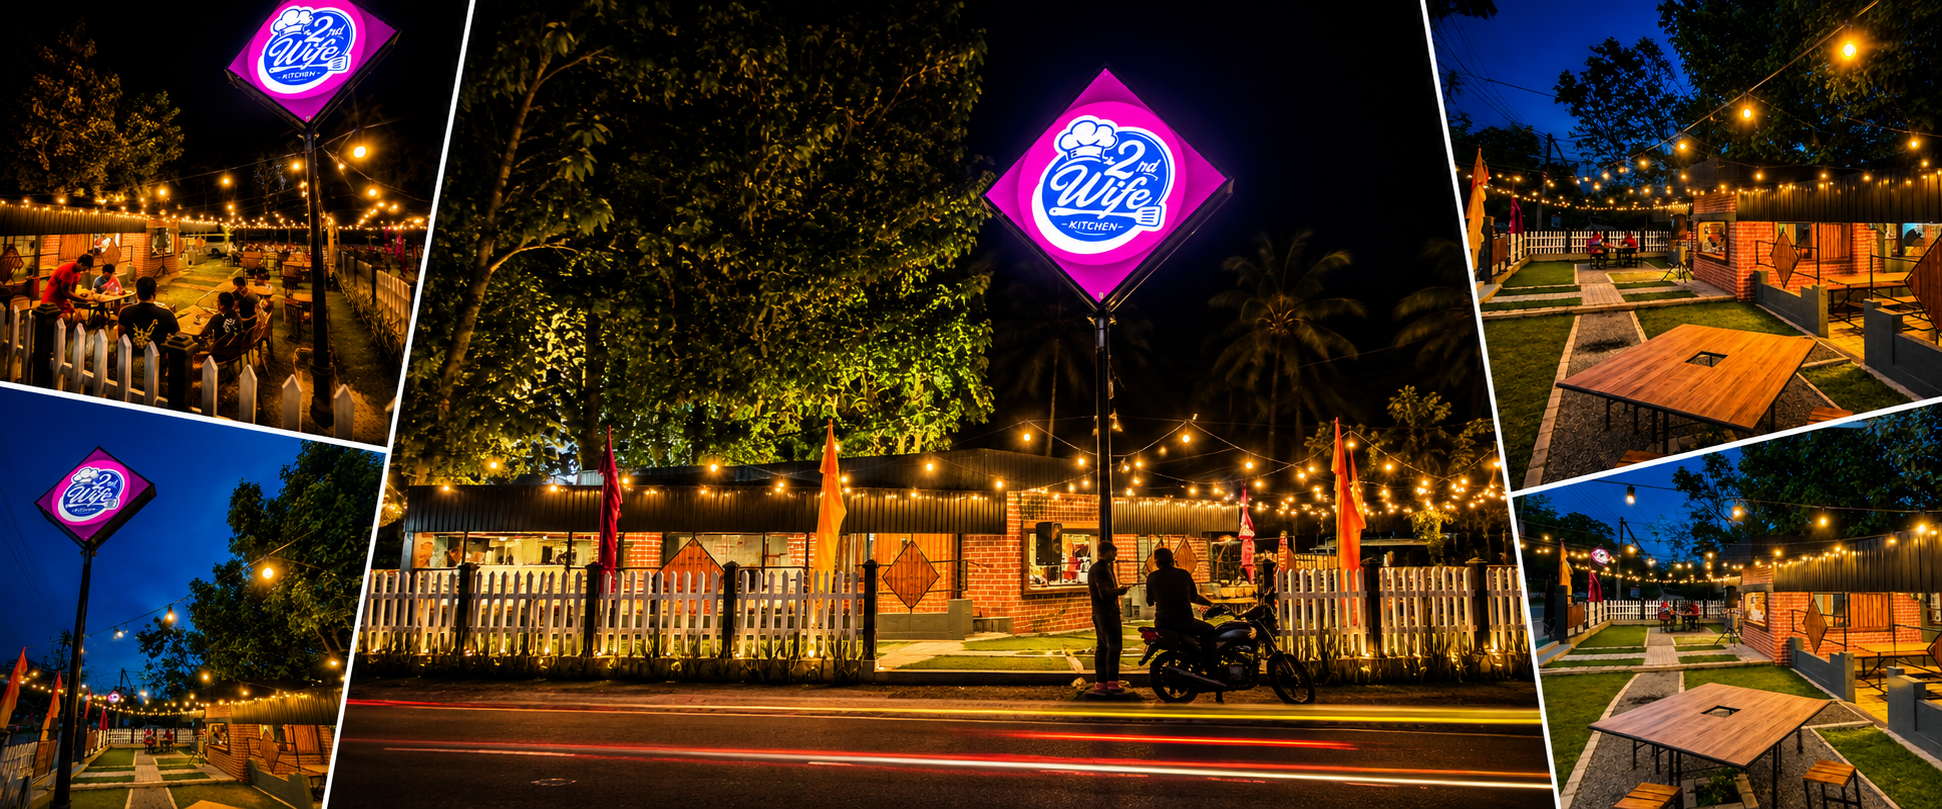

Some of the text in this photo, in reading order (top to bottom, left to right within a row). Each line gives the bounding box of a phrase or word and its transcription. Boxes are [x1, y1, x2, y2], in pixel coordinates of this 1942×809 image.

[304, 16, 346, 43] 2nd
[268, 38, 340, 70] Wife
[1104, 140, 1161, 180] 2nd
[1050, 165, 1152, 219] Wife
[1069, 220, 1118, 231] KITCHEN
[67, 486, 112, 507] Wife
